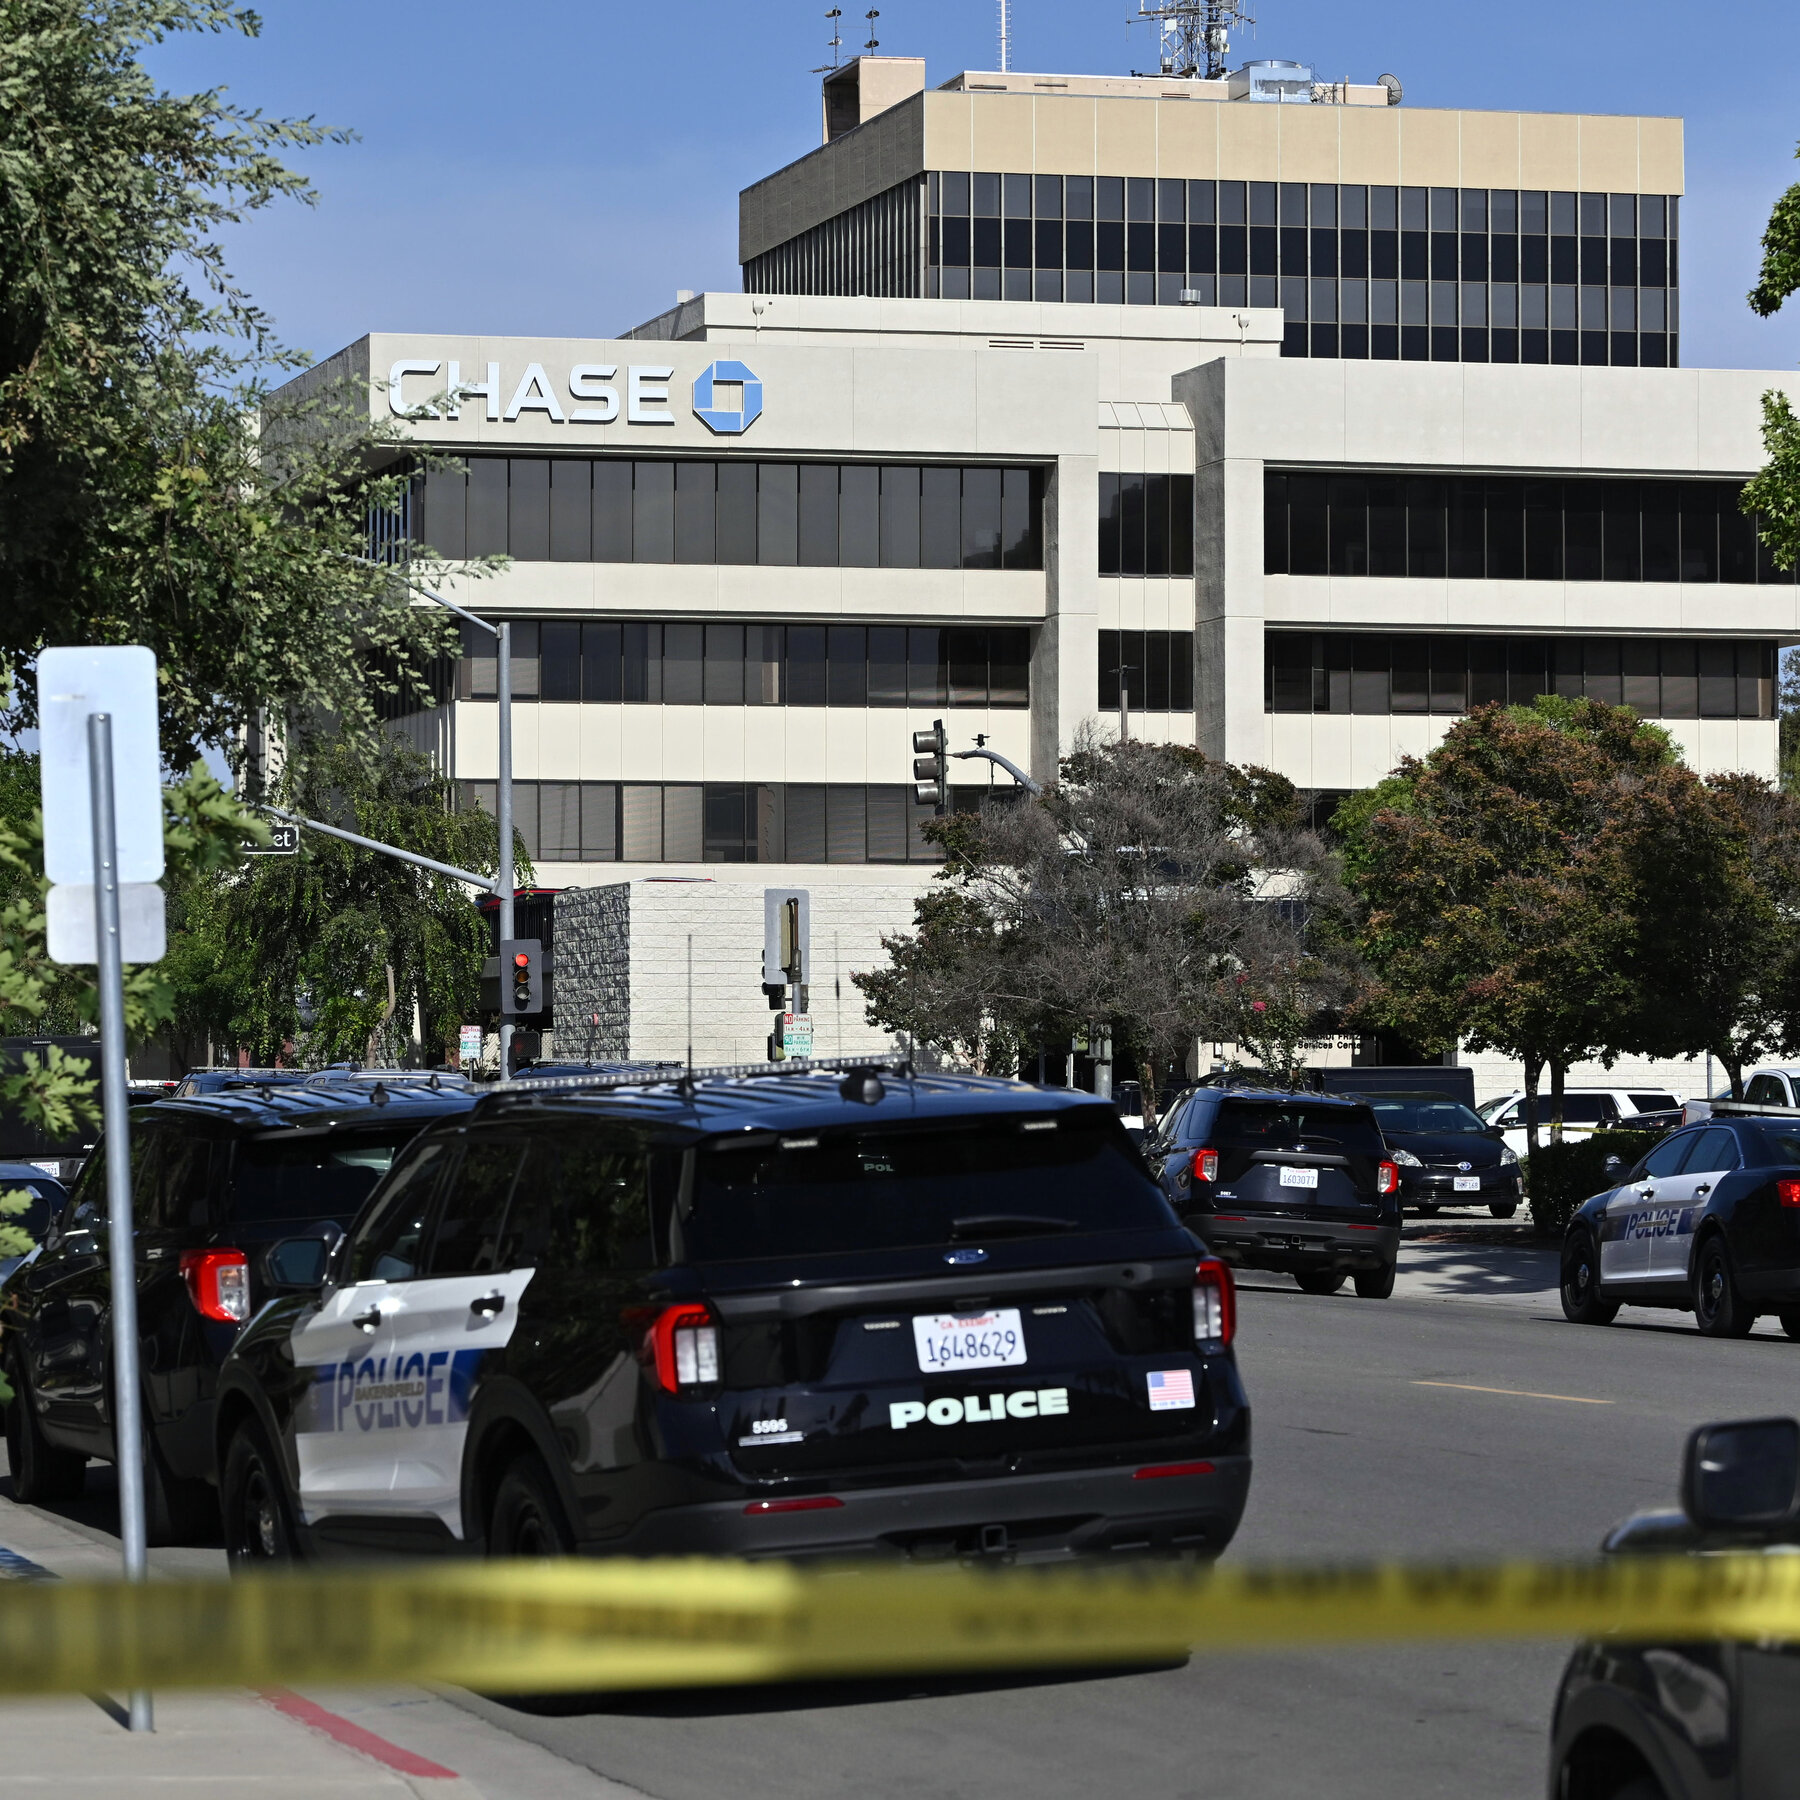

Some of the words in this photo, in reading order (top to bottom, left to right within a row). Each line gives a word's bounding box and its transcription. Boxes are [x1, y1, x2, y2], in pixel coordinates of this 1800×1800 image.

[389, 358, 675, 426] CHASE
[784, 1015, 793, 1024] NO
[1283, 1174, 1316, 1185] 1603077
[1626, 1209, 1680, 1241] POLICE
[927, 1330, 1016, 1362] 1648629
[337, 1351, 450, 1432] POLICE
[889, 1388, 1070, 1430] POLICE
